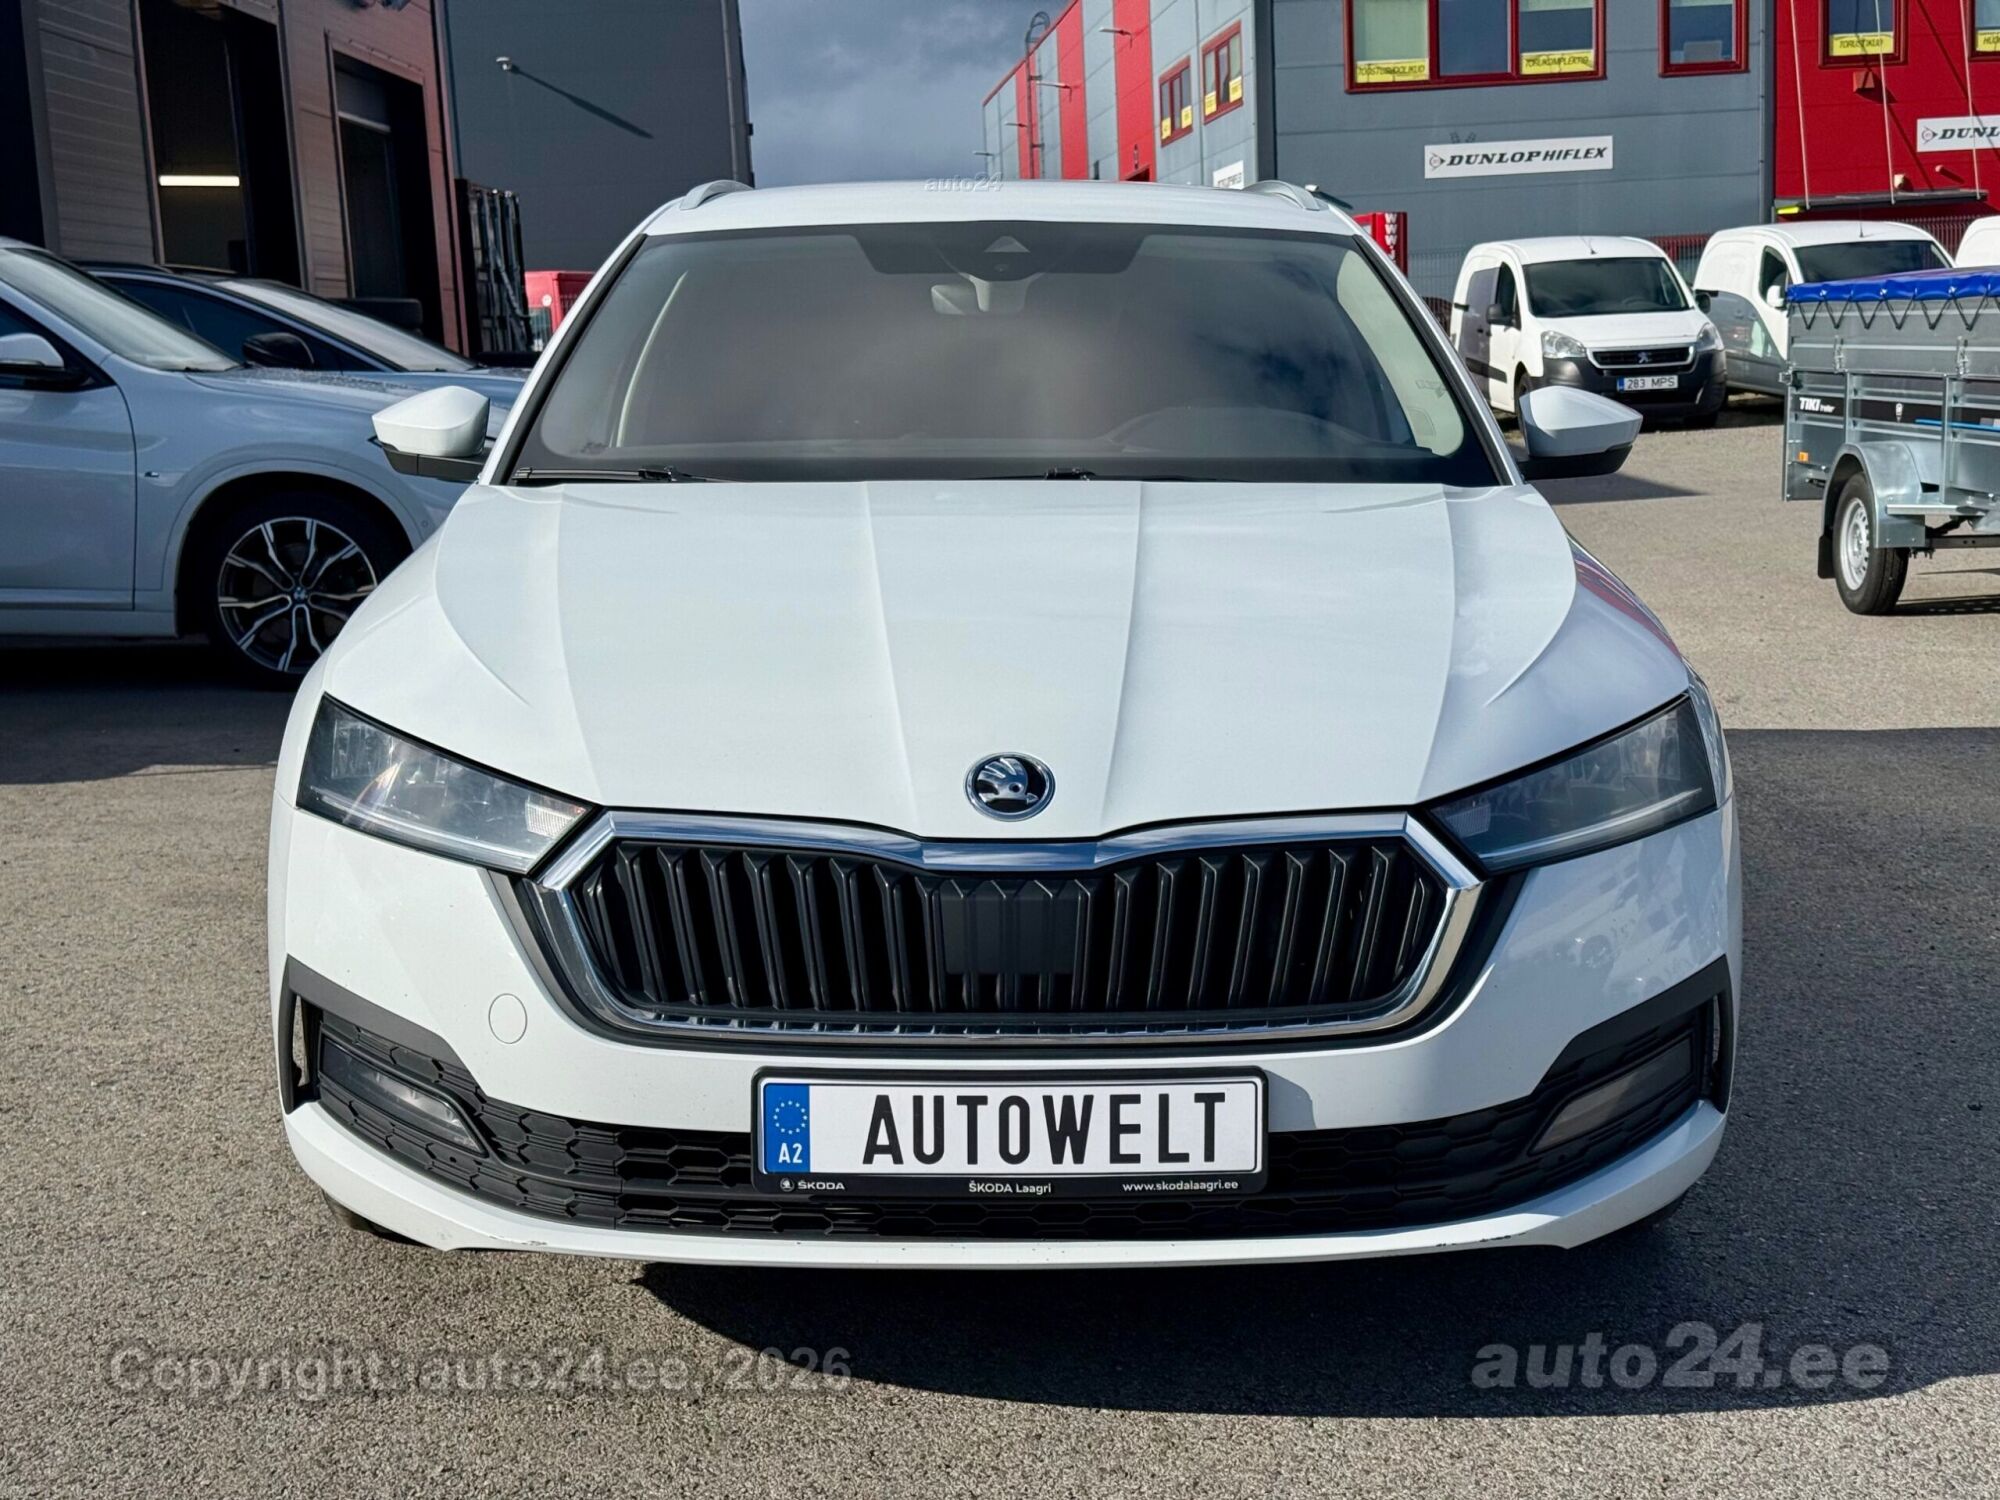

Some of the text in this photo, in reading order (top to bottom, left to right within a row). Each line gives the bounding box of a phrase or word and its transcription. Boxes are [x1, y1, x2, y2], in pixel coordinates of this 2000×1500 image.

[1627, 379, 1646, 390] 283
[1651, 377, 1675, 387] MPS
[1799, 396, 1821, 411] TIKI
[862, 1092, 1225, 1165] AUTOWELT
[778, 1142, 803, 1164] A2
[797, 1179, 845, 1190] ŠKODA
[968, 1181, 1052, 1195] ŠKODA Laagri
[1122, 1179, 1239, 1192] www.skodalaagri.ee
